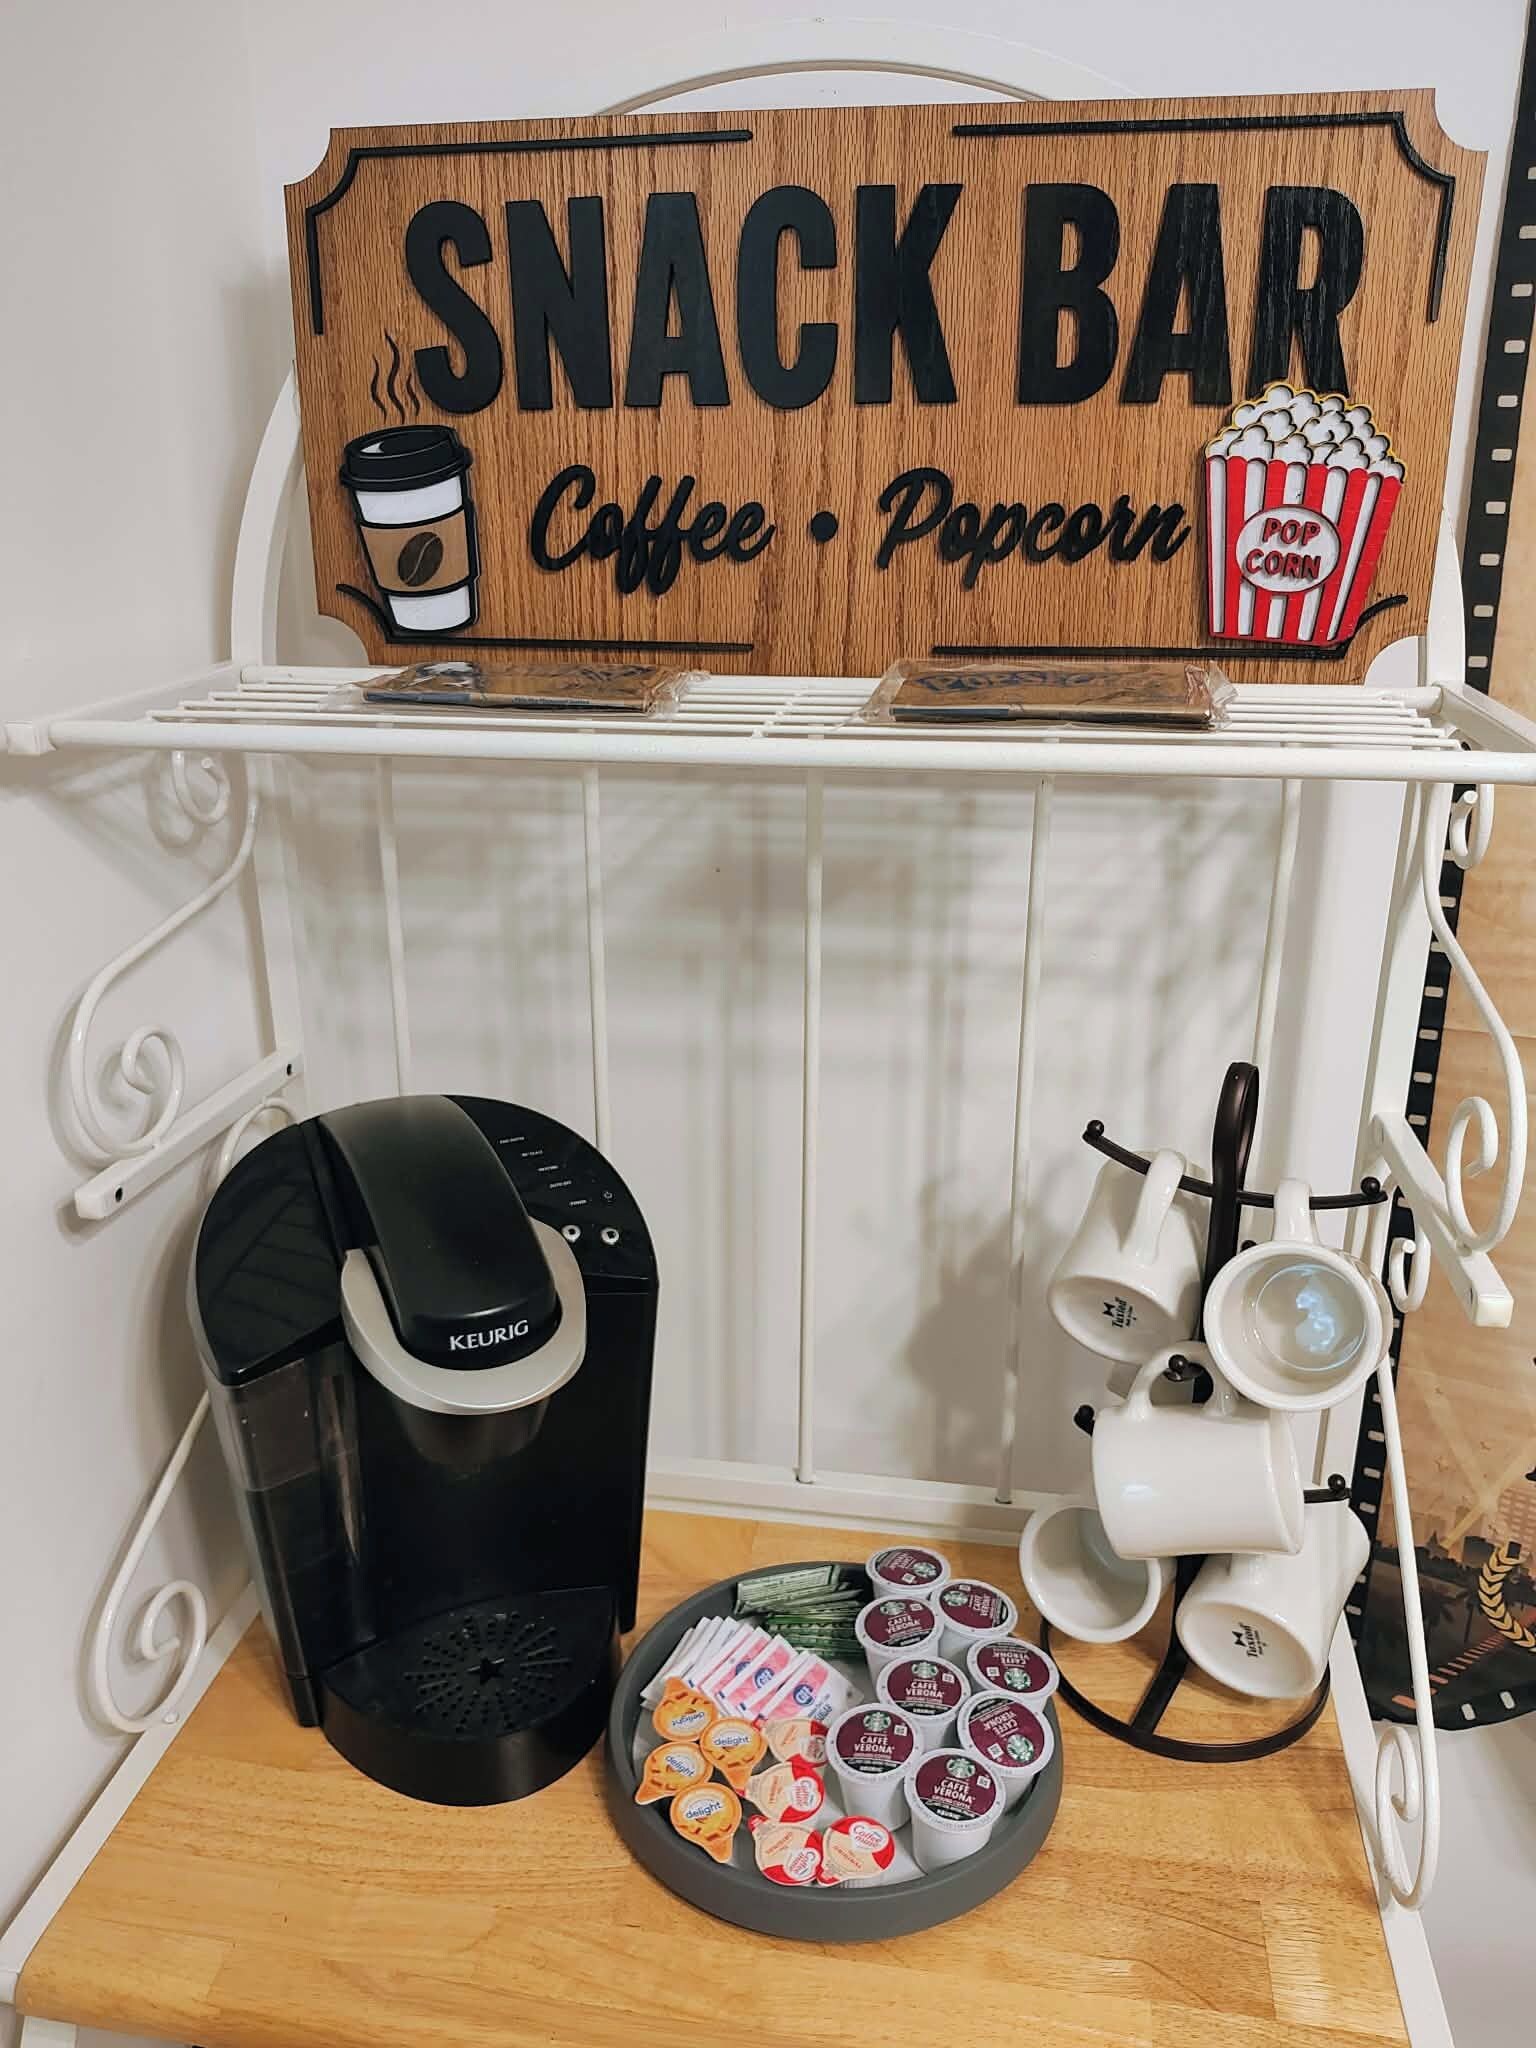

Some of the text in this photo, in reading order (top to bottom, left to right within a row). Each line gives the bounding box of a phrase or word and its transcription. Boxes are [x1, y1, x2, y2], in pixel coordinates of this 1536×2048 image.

[404, 182, 1366, 415] SNACK BAR
[529, 464, 1192, 597] Coffee Popcorn
[1262, 517, 1321, 546] POP
[1246, 548, 1321, 579] CORN
[449, 1319, 529, 1351] KEURIG
[714, 1736, 750, 1746] delight
[854, 1743, 893, 1754] VERONA
[665, 1755, 696, 1777] delight
[933, 1785, 974, 1804] VERONA
[686, 1802, 722, 1819] delight
[853, 1824, 883, 1843] Coffee
